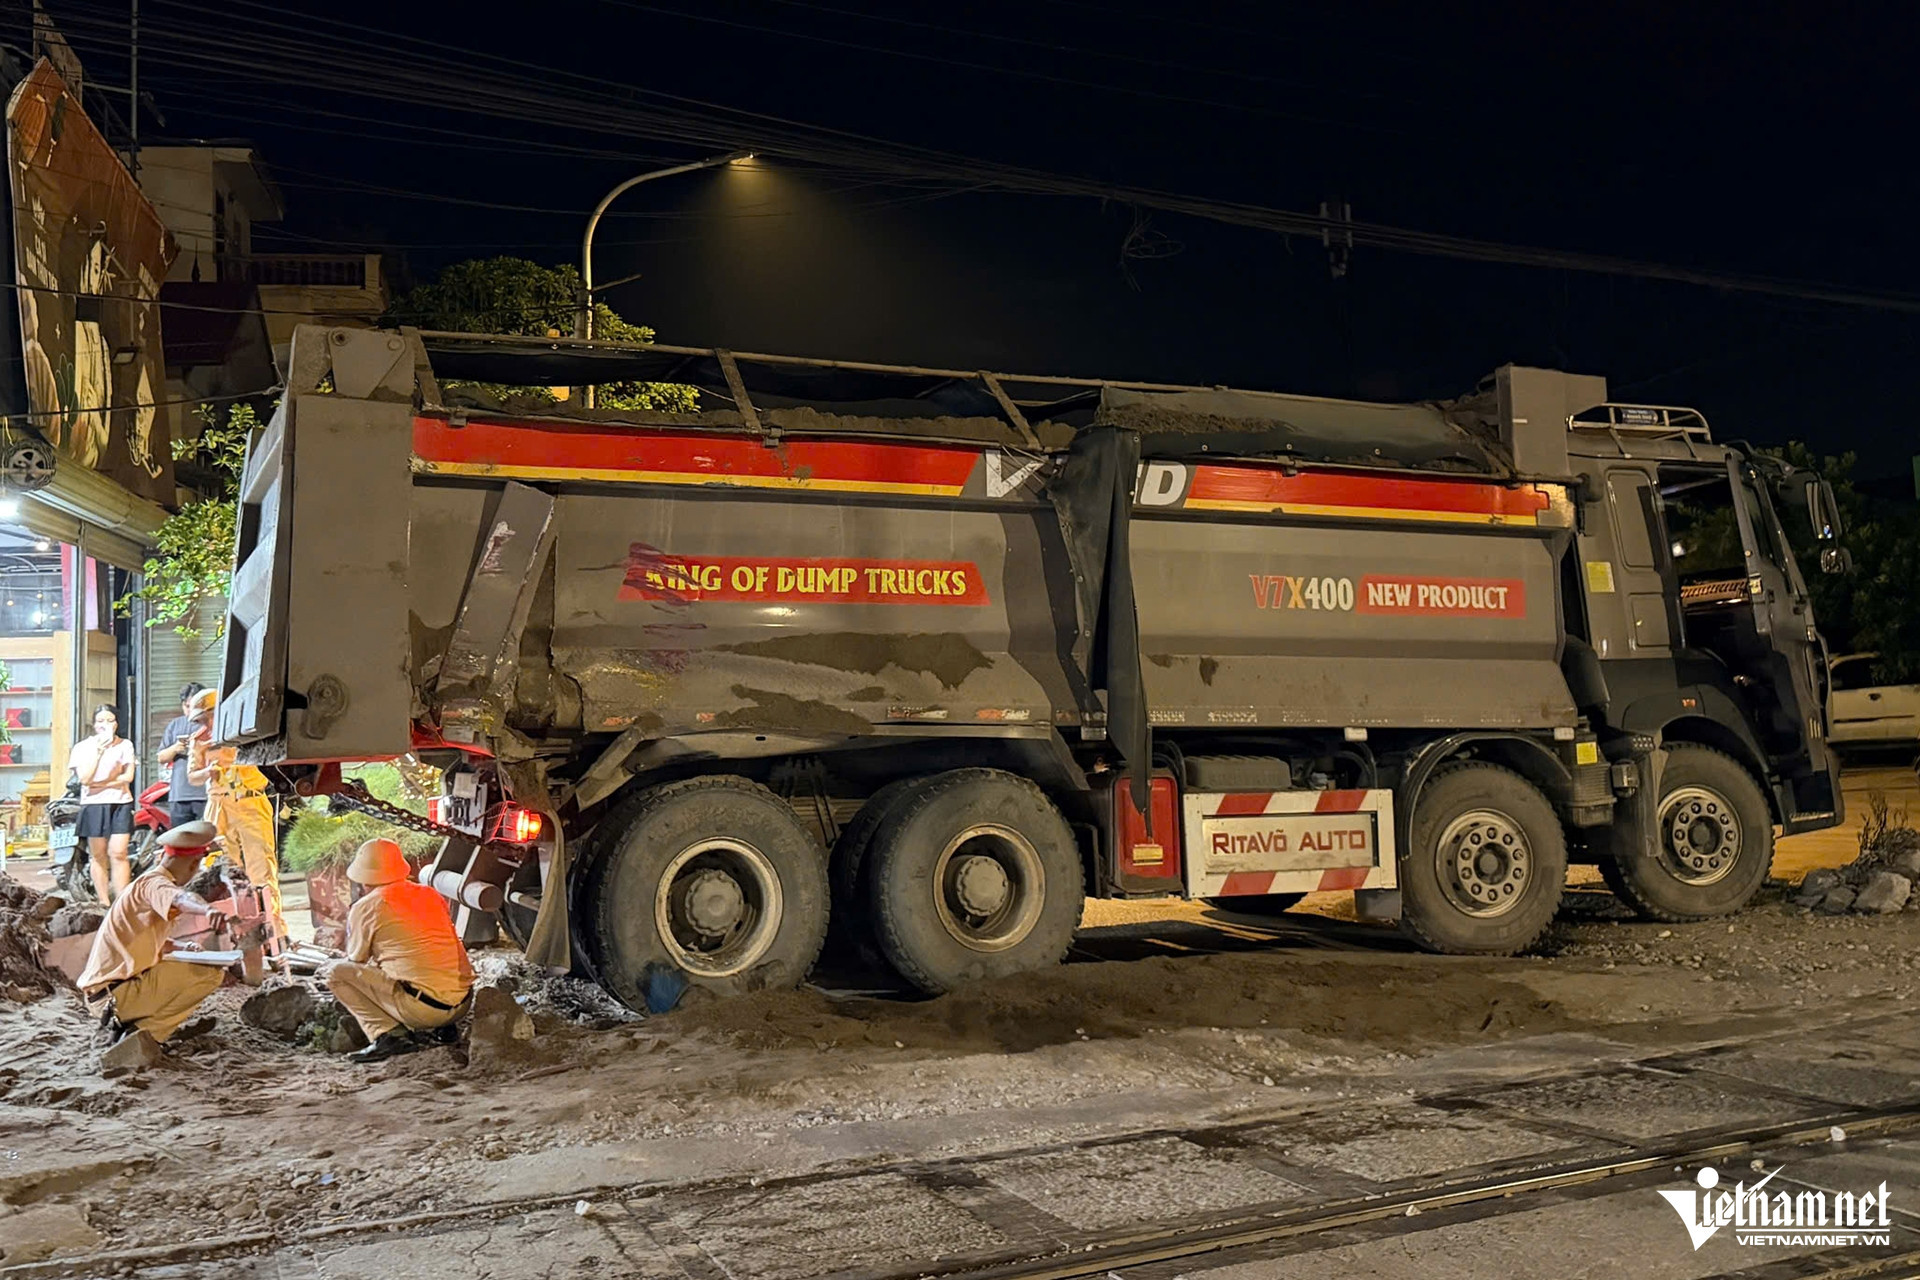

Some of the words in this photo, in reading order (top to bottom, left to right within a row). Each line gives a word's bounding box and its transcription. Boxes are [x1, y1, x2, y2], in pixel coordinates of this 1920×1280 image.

[645, 564, 722, 592] KING
[731, 566, 770, 592] OF
[776, 567, 858, 593] DUMP
[864, 568, 967, 596] TRUCKS
[1249, 574, 1354, 611] V7X400
[1366, 582, 1412, 607] NEW
[1417, 584, 1508, 610] PRODUCT
[1298, 830, 1366, 851] AUTO
